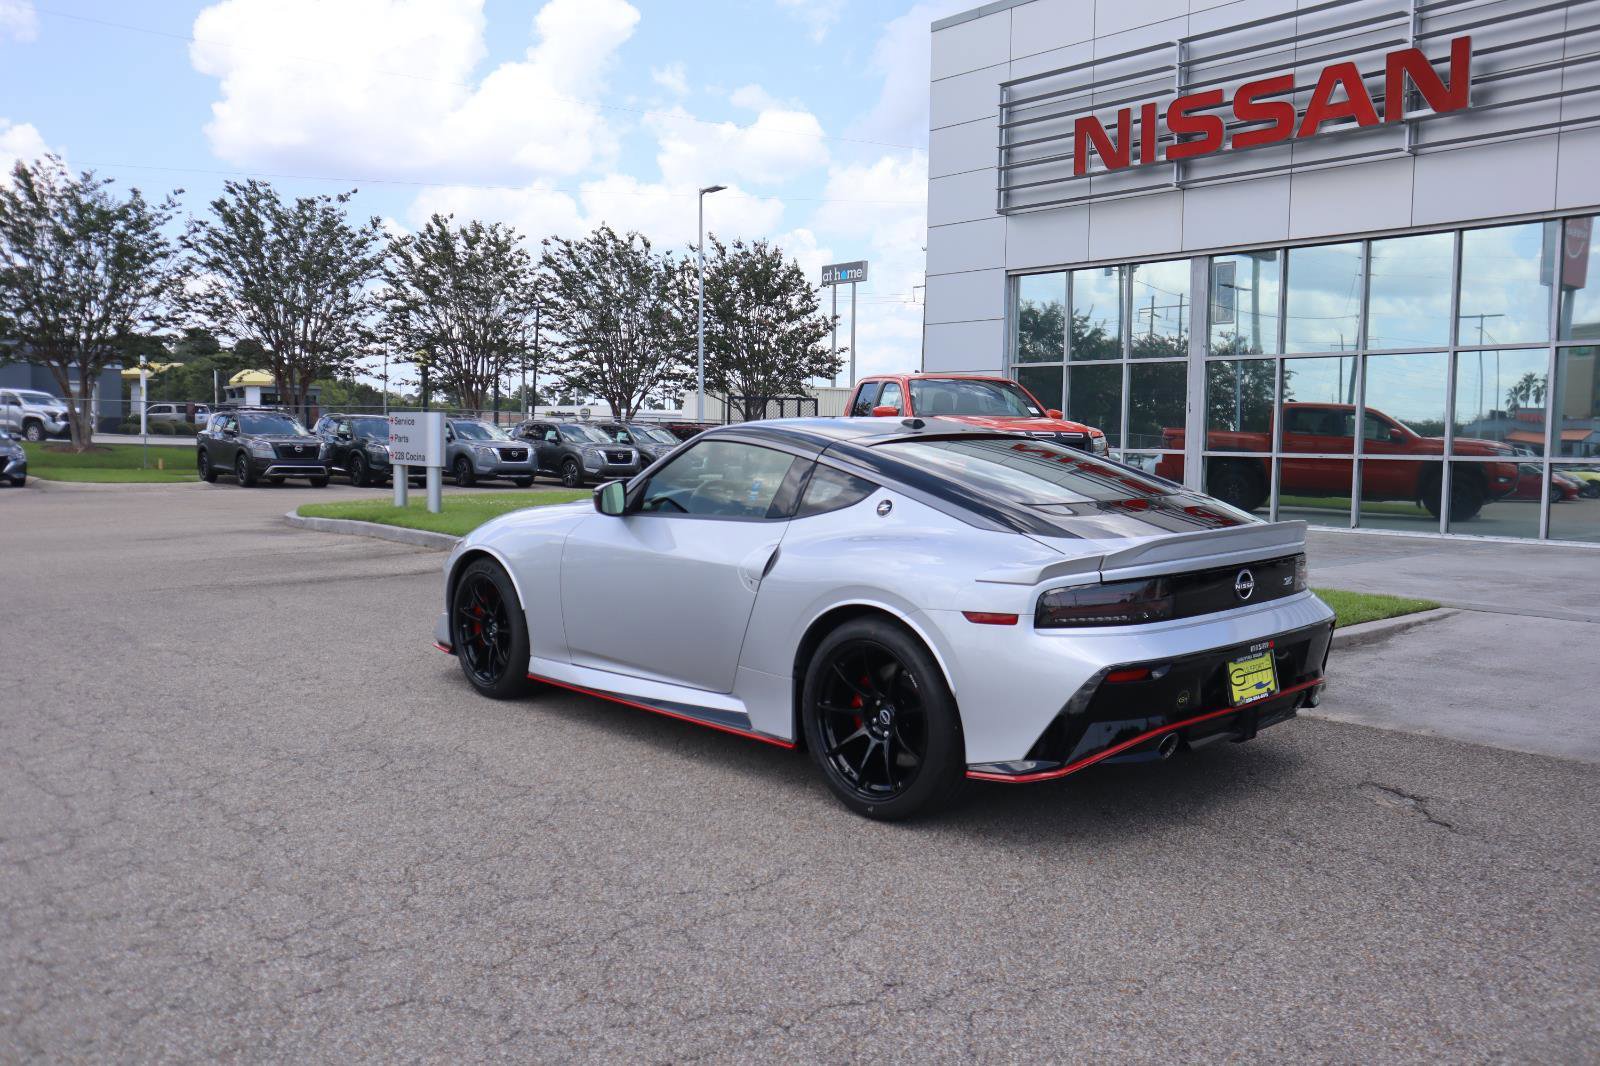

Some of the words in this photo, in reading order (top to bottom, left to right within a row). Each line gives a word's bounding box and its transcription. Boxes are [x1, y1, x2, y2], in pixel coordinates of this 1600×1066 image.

[1073, 35, 1472, 177] NISSAN
[822, 269, 833, 281] at
[834, 267, 863, 280] home
[394, 416, 415, 426] Service
[394, 433, 409, 443] Parts
[405, 451, 426, 461] Cocina
[1235, 581, 1255, 590] NISSAN
